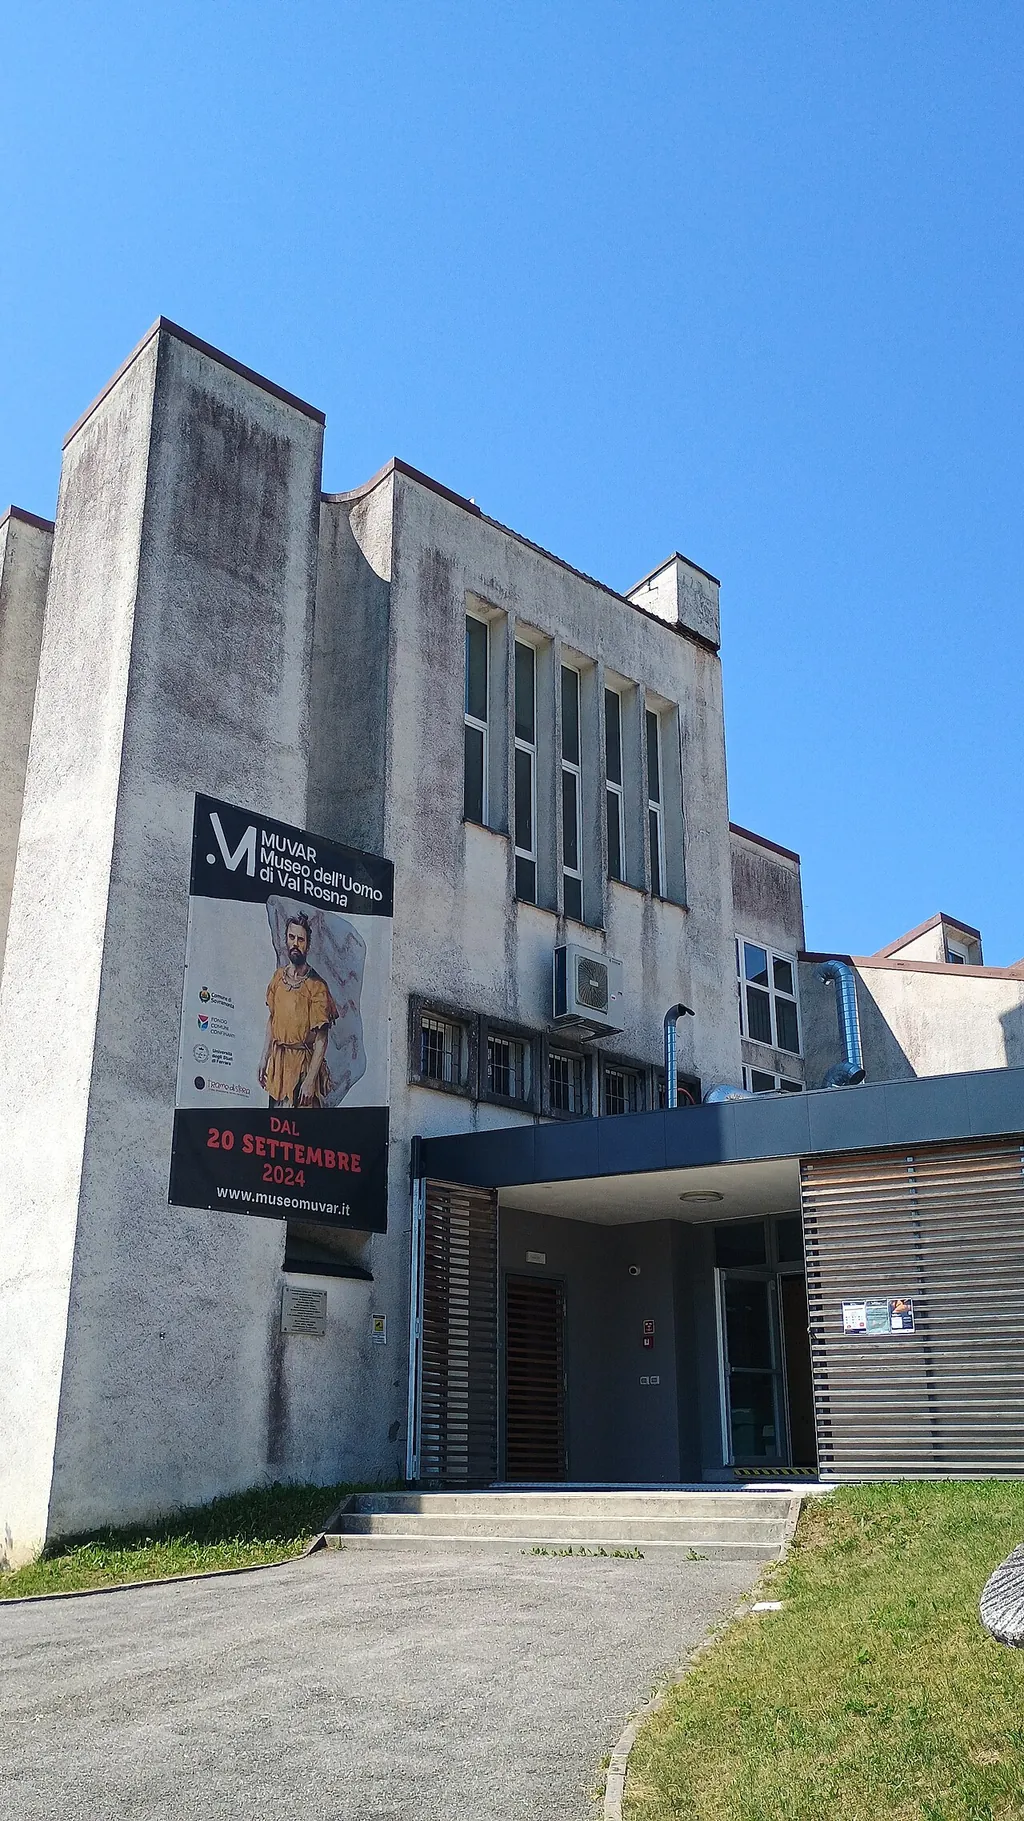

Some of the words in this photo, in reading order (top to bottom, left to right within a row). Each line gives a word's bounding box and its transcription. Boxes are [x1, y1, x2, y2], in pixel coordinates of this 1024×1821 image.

[261, 830, 317, 863] MUVAR
[260, 847, 310, 878] Museo
[259, 867, 274, 883] di
[278, 871, 300, 891] Val
[304, 880, 348, 907] Rosna
[270, 1117, 300, 1136] DAL
[207, 1128, 235, 1151] 20
[241, 1133, 362, 1172] SETTEMBRE
[262, 1163, 306, 1188] 2024
[216, 1186, 350, 1216] www.museomuvar.it
